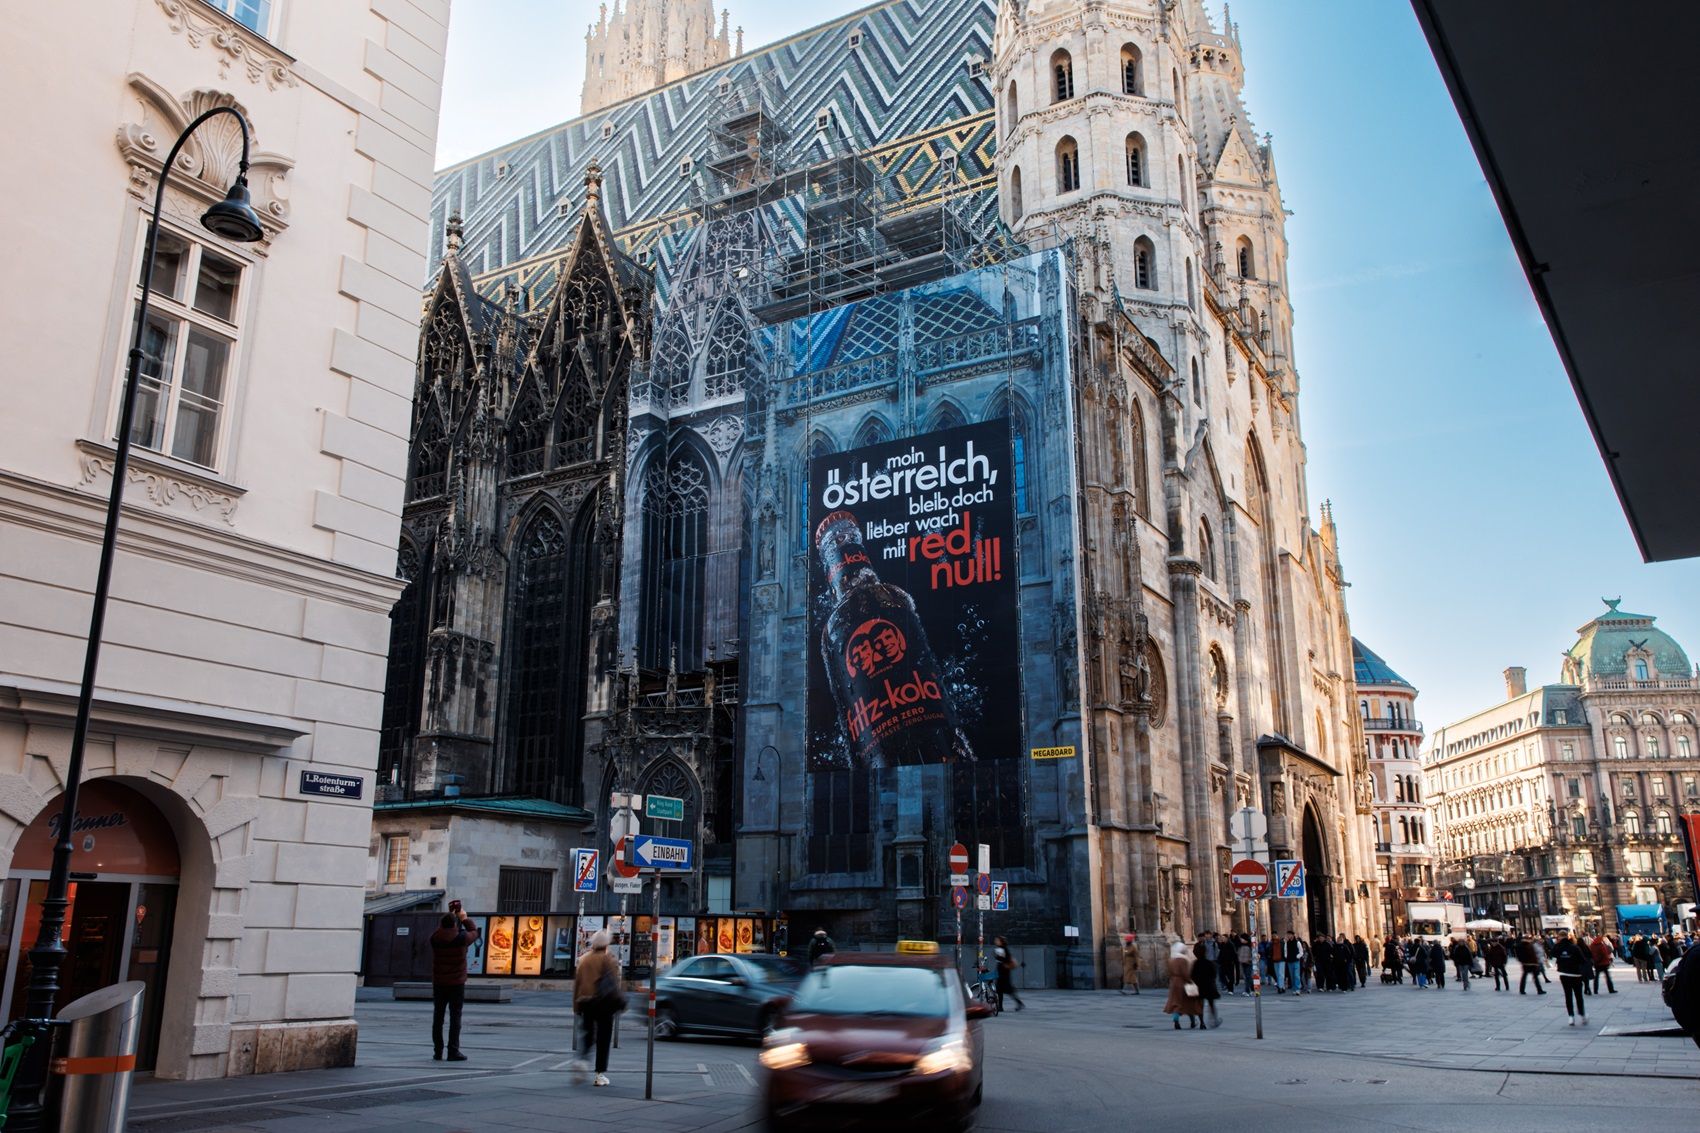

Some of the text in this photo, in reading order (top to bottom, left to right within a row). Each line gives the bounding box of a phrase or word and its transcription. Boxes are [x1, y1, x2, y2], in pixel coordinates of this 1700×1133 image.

[887, 446, 924, 469] moin
[822, 440, 998, 509] österreich,
[909, 483, 994, 515] bleib doch
[866, 507, 959, 540] lieber wach
[883, 511, 971, 562] mit red
[931, 537, 1001, 590] null!
[871, 707, 925, 738] SUPER ZERO
[1033, 748, 1073, 757] MEGABOARD
[319, 785, 345, 794] straße
[653, 846, 685, 860] EINBAHN
